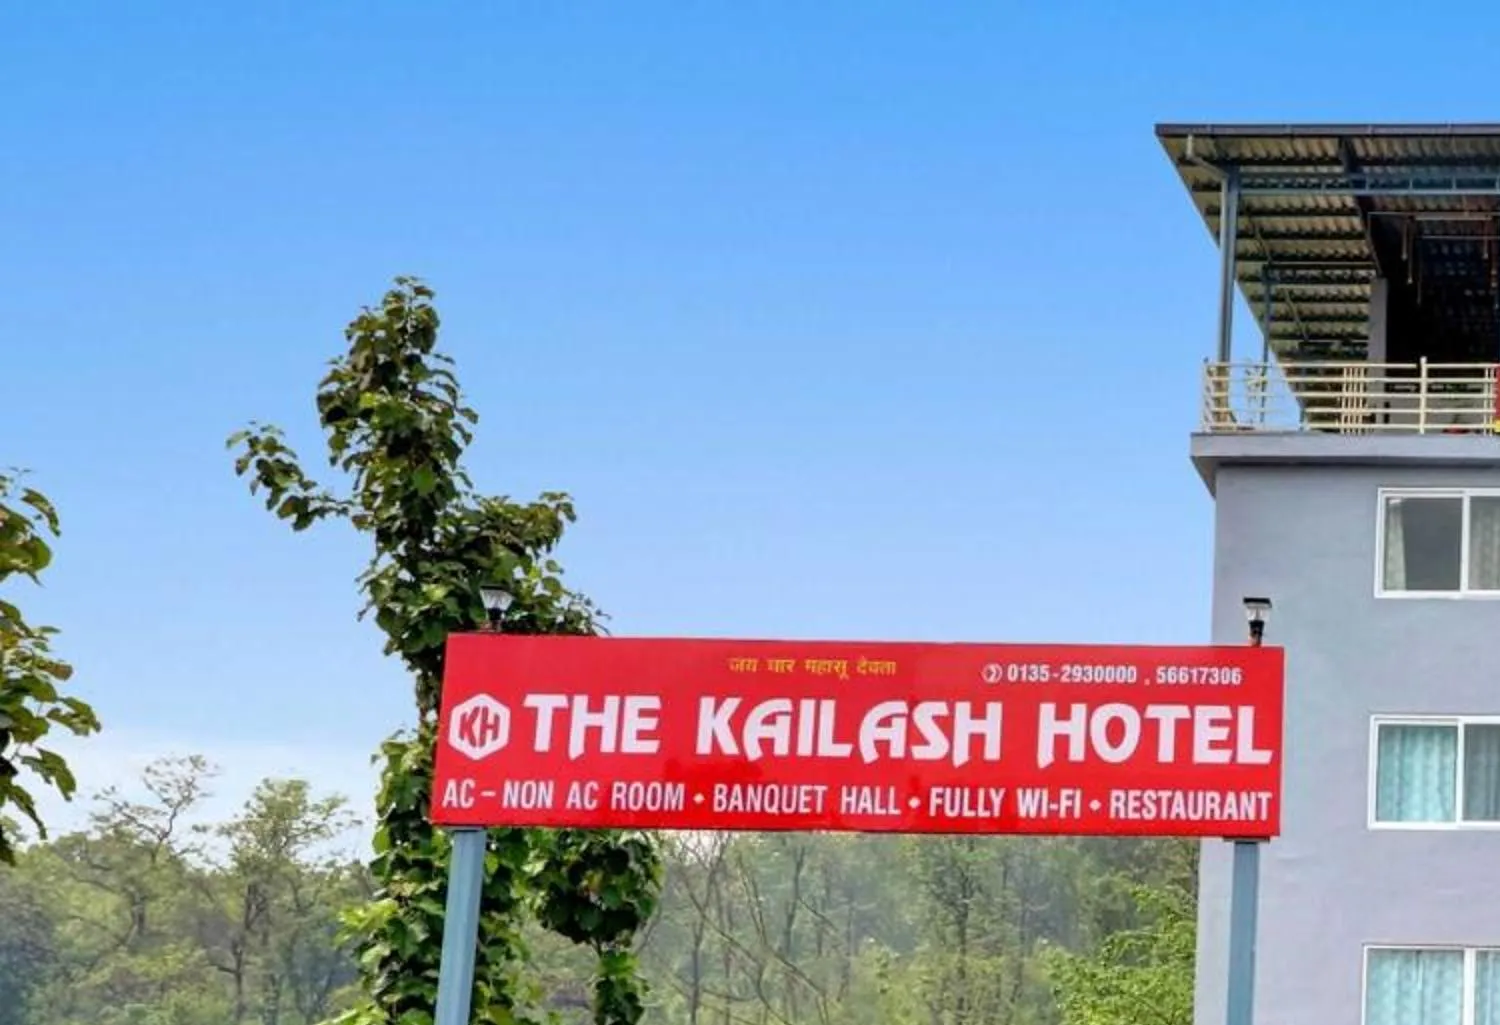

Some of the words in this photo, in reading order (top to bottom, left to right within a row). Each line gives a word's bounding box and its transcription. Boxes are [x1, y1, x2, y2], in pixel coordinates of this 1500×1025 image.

[728, 657, 757, 673] जय
[1156, 666, 1242, 685] 56617306
[455, 702, 503, 751] KH
[523, 693, 661, 760] THE
[695, 695, 1001, 768] KAILASH
[1036, 702, 1273, 769] HOTEL
[442, 780, 475, 808] AC
[503, 780, 554, 809] NON
[565, 781, 599, 810] AC
[611, 782, 686, 812] ROOM
[713, 784, 828, 815] BANQUET
[841, 785, 901, 816] HALL
[929, 787, 1006, 818] FULLY
[1016, 788, 1081, 819] WI-FI
[1109, 790, 1272, 822] RESTAURANT
